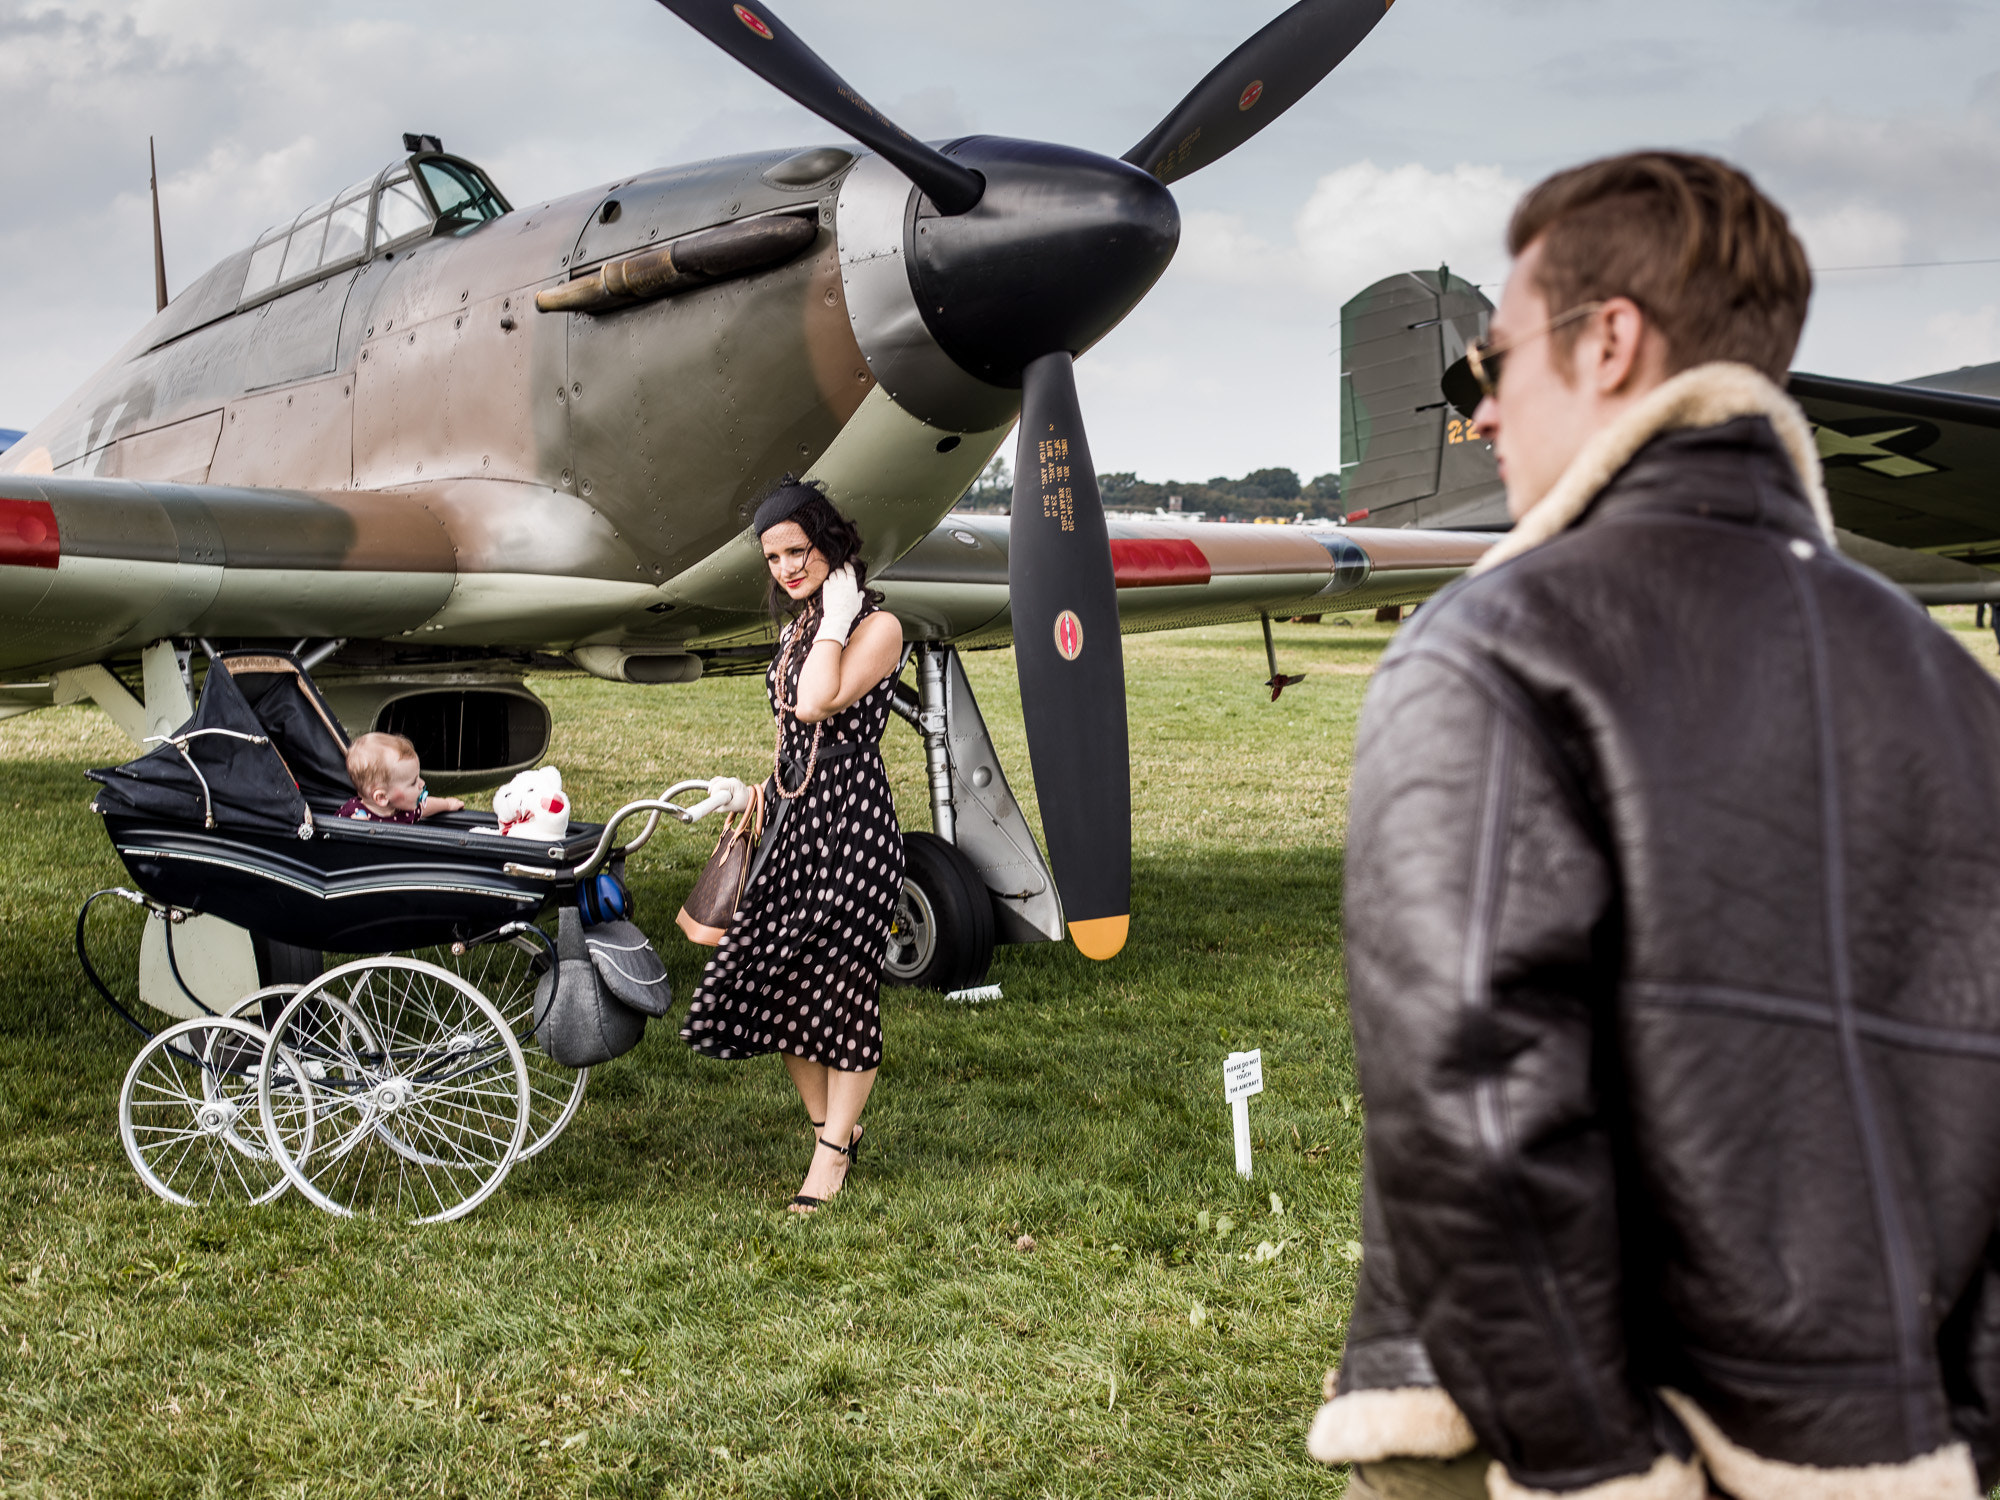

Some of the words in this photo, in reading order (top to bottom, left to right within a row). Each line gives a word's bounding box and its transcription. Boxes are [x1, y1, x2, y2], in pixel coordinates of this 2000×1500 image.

[1226, 1064, 1241, 1072] PLEASE
[1236, 1072, 1252, 1080] TOUCH
[1239, 1079, 1259, 1090] AIRCRAFT
